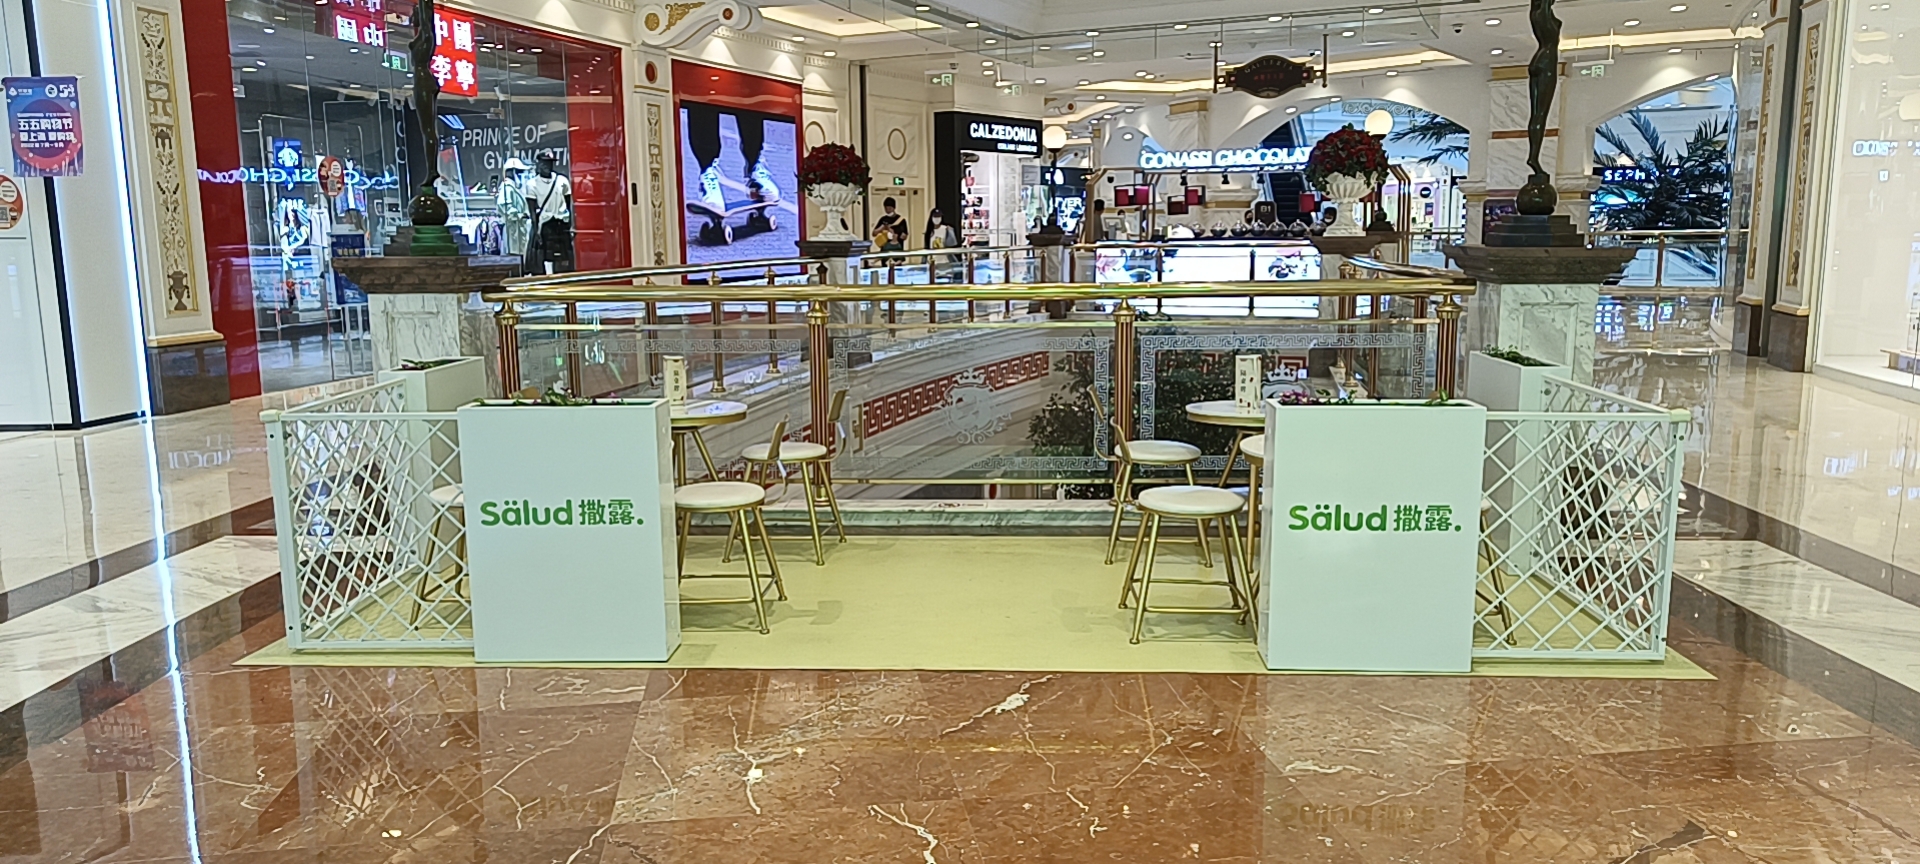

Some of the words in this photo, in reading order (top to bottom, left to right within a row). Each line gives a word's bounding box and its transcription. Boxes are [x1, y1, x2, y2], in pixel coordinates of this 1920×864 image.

[462, 126, 521, 148] PRINCE
[524, 124, 548, 144] OF
[970, 123, 1038, 143] CALZEDONIA
[480, 499, 573, 526] Sälud
[1288, 504, 1387, 531] Sälud
